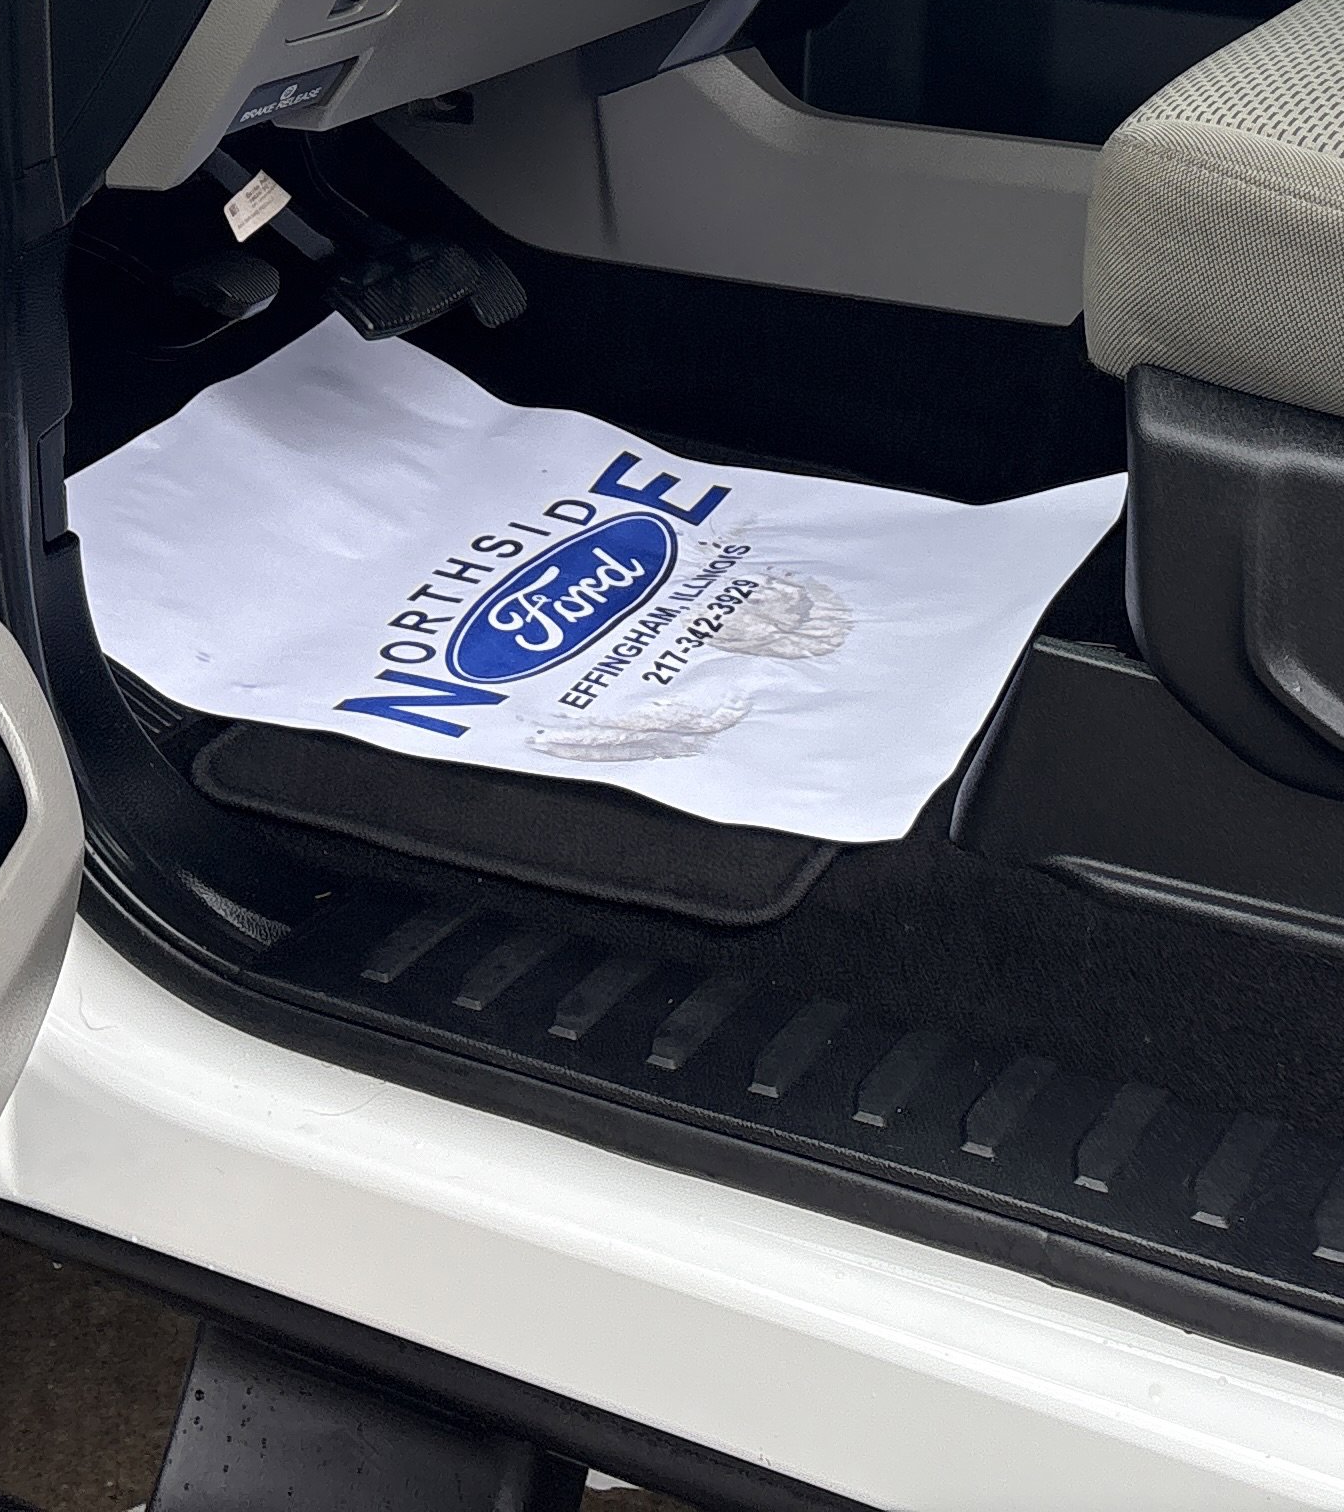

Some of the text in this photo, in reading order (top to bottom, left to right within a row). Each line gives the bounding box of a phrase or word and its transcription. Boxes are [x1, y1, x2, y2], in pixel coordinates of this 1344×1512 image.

[240, 87, 322, 123] BRAKE RELEASE
[333, 450, 732, 738] NORTHSIDE
[488, 547, 645, 652] Ford
[559, 544, 752, 710] EFFINGHAM, ILLINOIS
[642, 579, 760, 686] 217-342-3929
